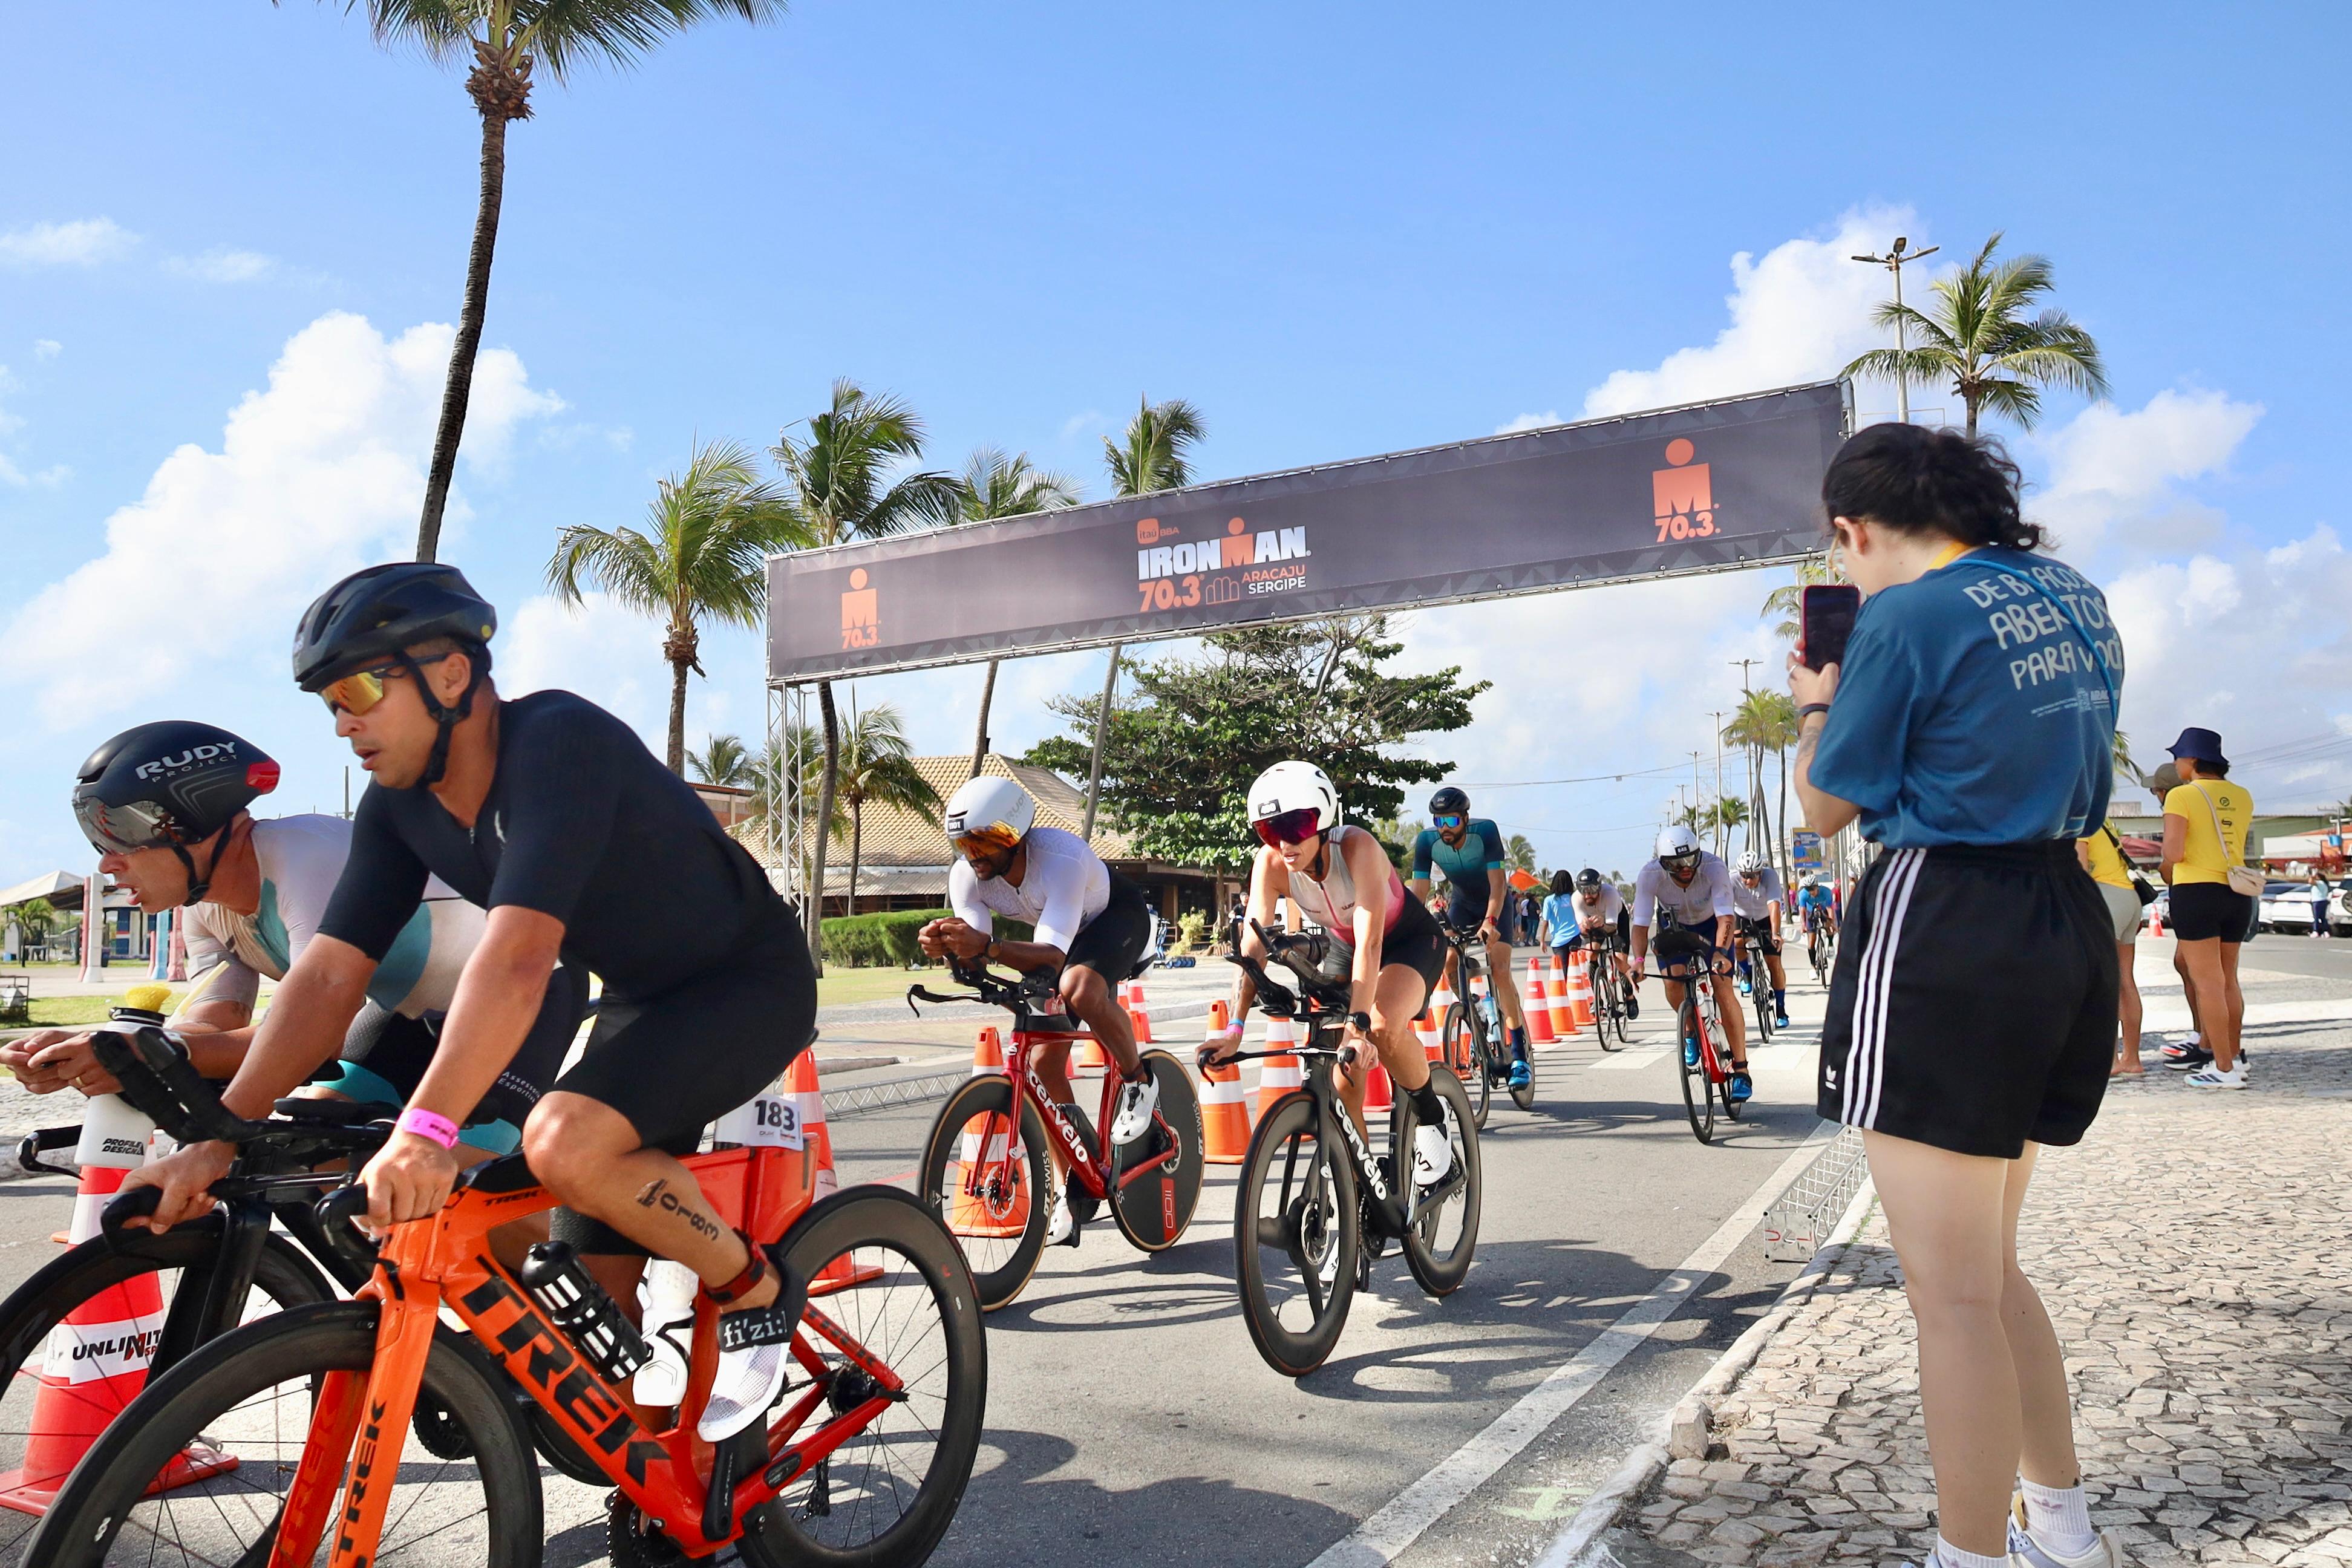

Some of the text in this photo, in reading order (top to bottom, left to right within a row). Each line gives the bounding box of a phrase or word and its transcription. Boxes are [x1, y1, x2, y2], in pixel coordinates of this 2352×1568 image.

[1160, 526, 1180, 537] BBA
[1137, 517, 1307, 581] IRONMAN
[1241, 564, 1306, 584] ARACAJU
[1248, 576, 1307, 595] SERGIPE
[1138, 575, 1201, 613] 70.3
[1962, 579, 2010, 609] DE
[2010, 641, 2077, 690] PARA
[135, 741, 236, 780] RUDY
[152, 754, 237, 783] PROJECT
[754, 1100, 795, 1131] 183
[101, 1145, 139, 1155] DESIGN
[103, 1138, 142, 1148] PROFILE
[1042, 1149, 1051, 1190] SWISS
[72, 1328, 162, 1361] UNLIMIT
[724, 1310, 787, 1348] fi'zi:
[461, 1254, 673, 1489] TREK
[335, 1400, 387, 1563] TREK
